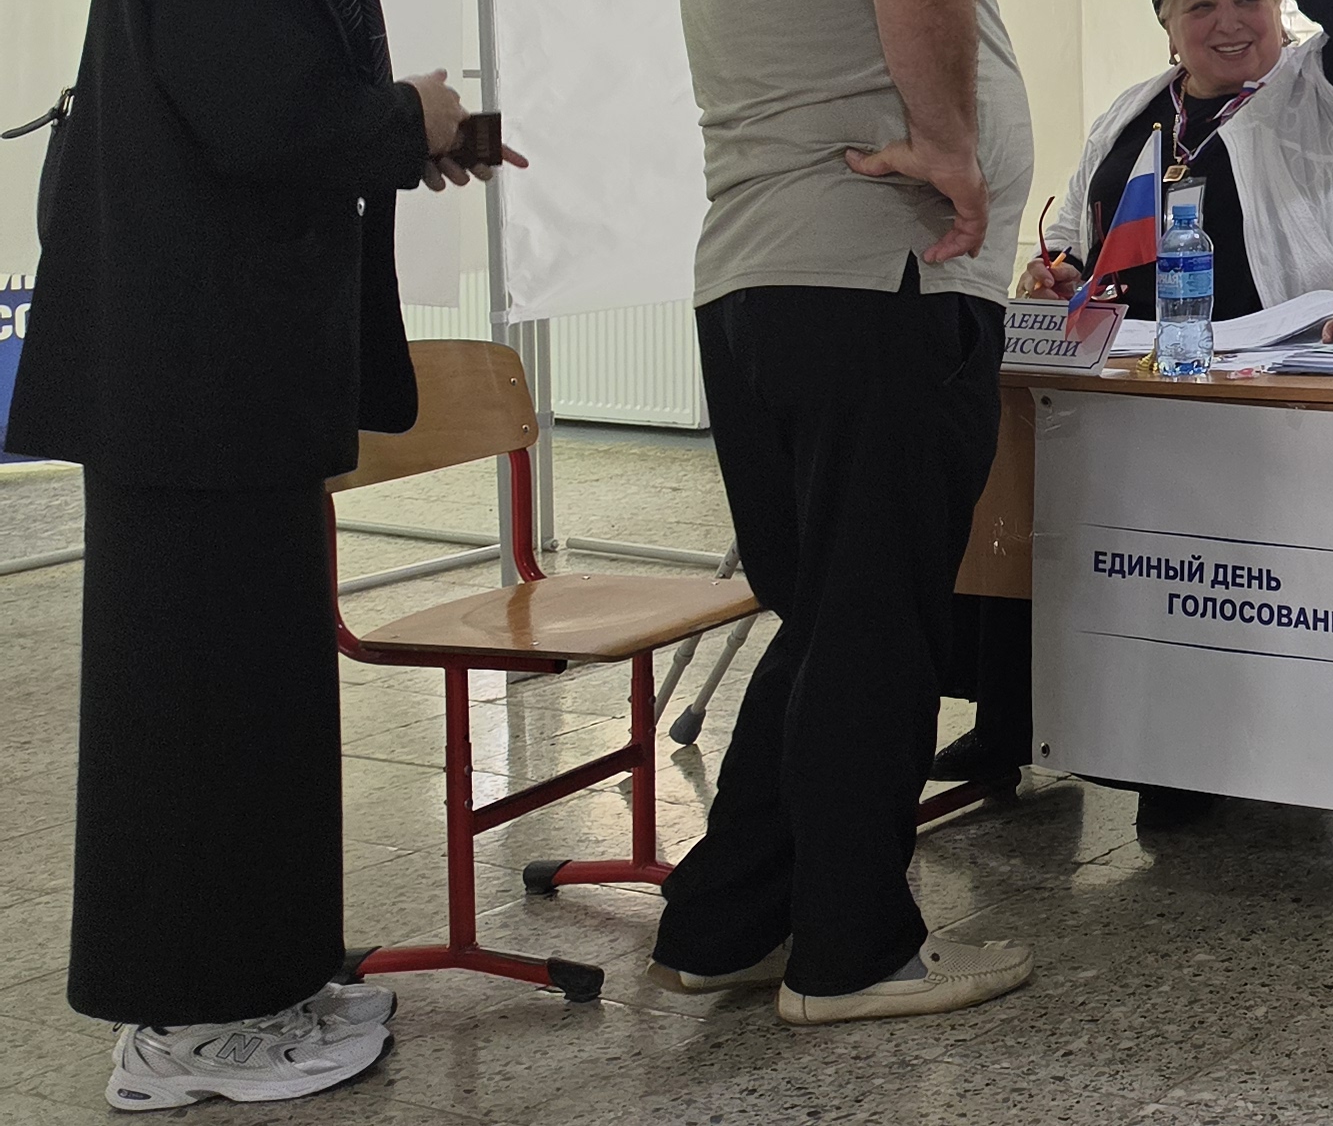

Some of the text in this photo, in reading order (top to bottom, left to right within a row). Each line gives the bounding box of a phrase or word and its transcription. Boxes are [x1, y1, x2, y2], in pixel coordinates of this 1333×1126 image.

[1004, 313, 1067, 331] ЛЕНЫ
[1004, 337, 1082, 357] ИССИИ
[1093, 551, 1282, 591] ЕДИНЫЙ ДЕНЬ
[216, 1032, 264, 1064] N
